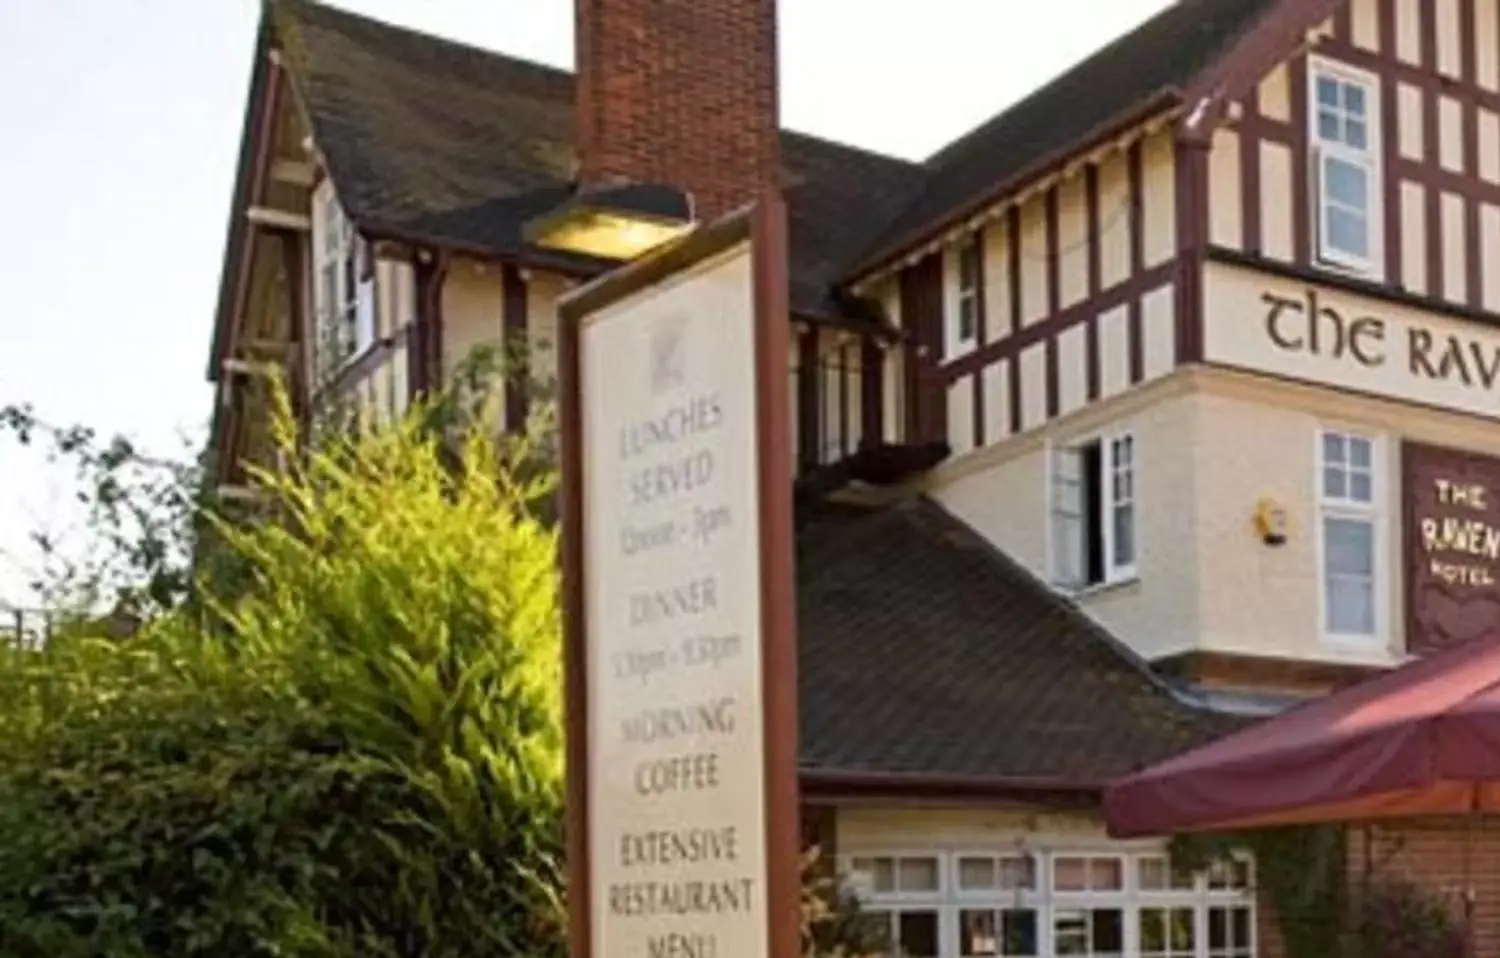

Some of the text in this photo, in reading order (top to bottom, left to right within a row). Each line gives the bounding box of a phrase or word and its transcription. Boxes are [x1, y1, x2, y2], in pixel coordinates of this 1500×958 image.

[618, 394, 723, 461] LUNCHES
[629, 450, 714, 506] SERVED
[1434, 479, 1487, 510] THE
[1430, 562, 1494, 587] HOTEL
[629, 575, 717, 627] DINNER
[621, 696, 736, 744] MORNING
[634, 752, 719, 796] COFFEE
[620, 826, 737, 868] EXTENSIVE
[609, 877, 754, 916] RESTAURANT
